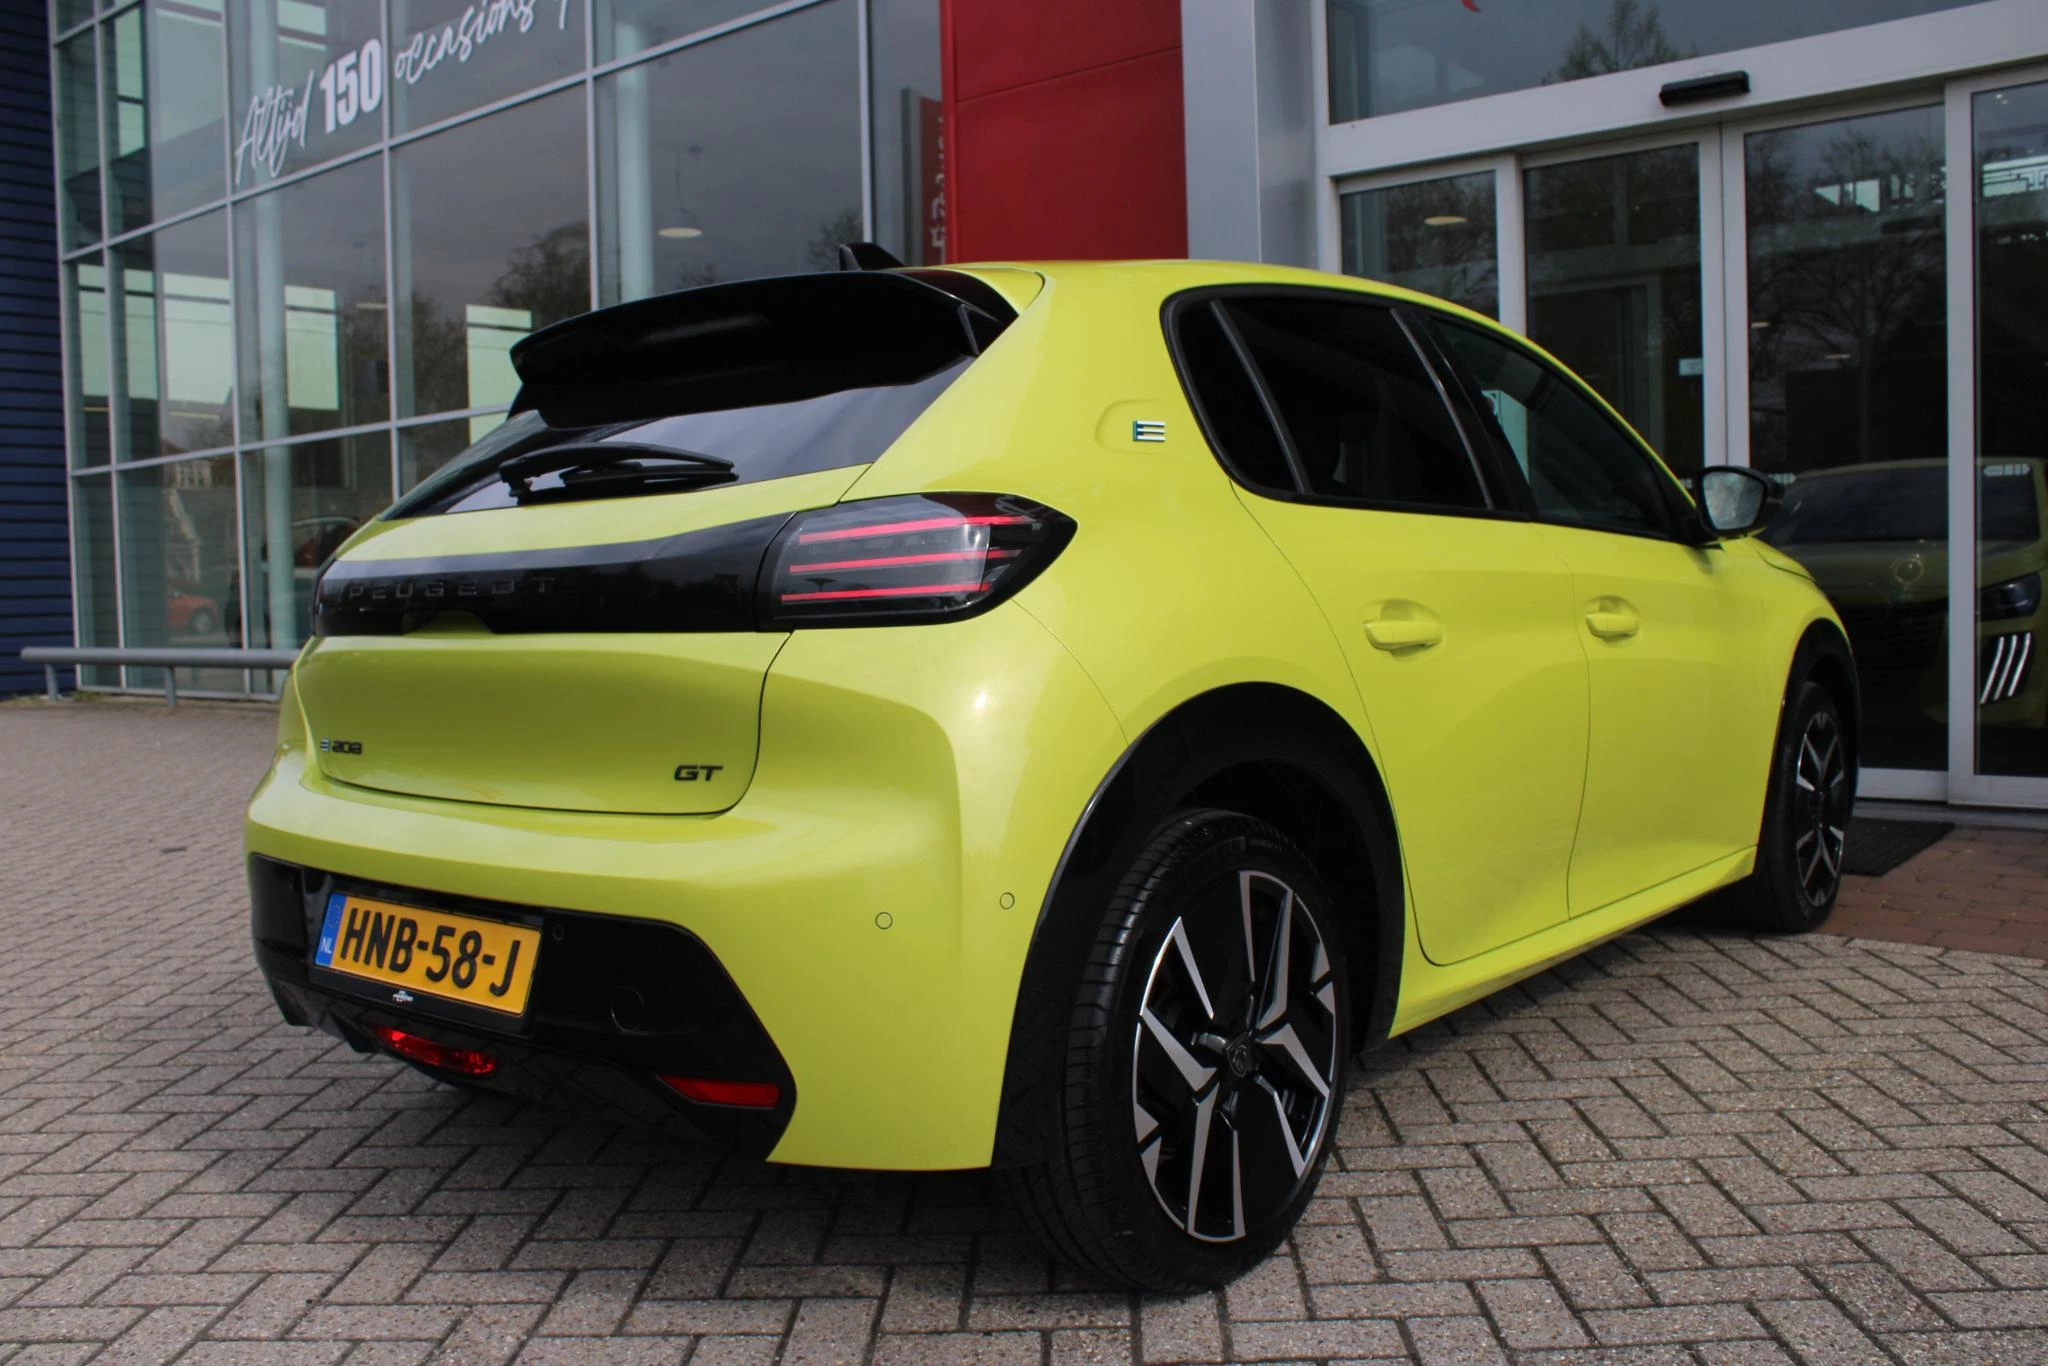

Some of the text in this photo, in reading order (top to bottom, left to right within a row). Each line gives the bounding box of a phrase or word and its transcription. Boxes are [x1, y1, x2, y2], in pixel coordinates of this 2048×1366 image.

[235, 69, 314, 185] Altijd
[319, 38, 383, 134] 150
[349, 576, 555, 600] PEUGEOT
[674, 764, 724, 782] GT
[320, 936, 333, 955] NL
[339, 907, 522, 997] HNB-58-J
